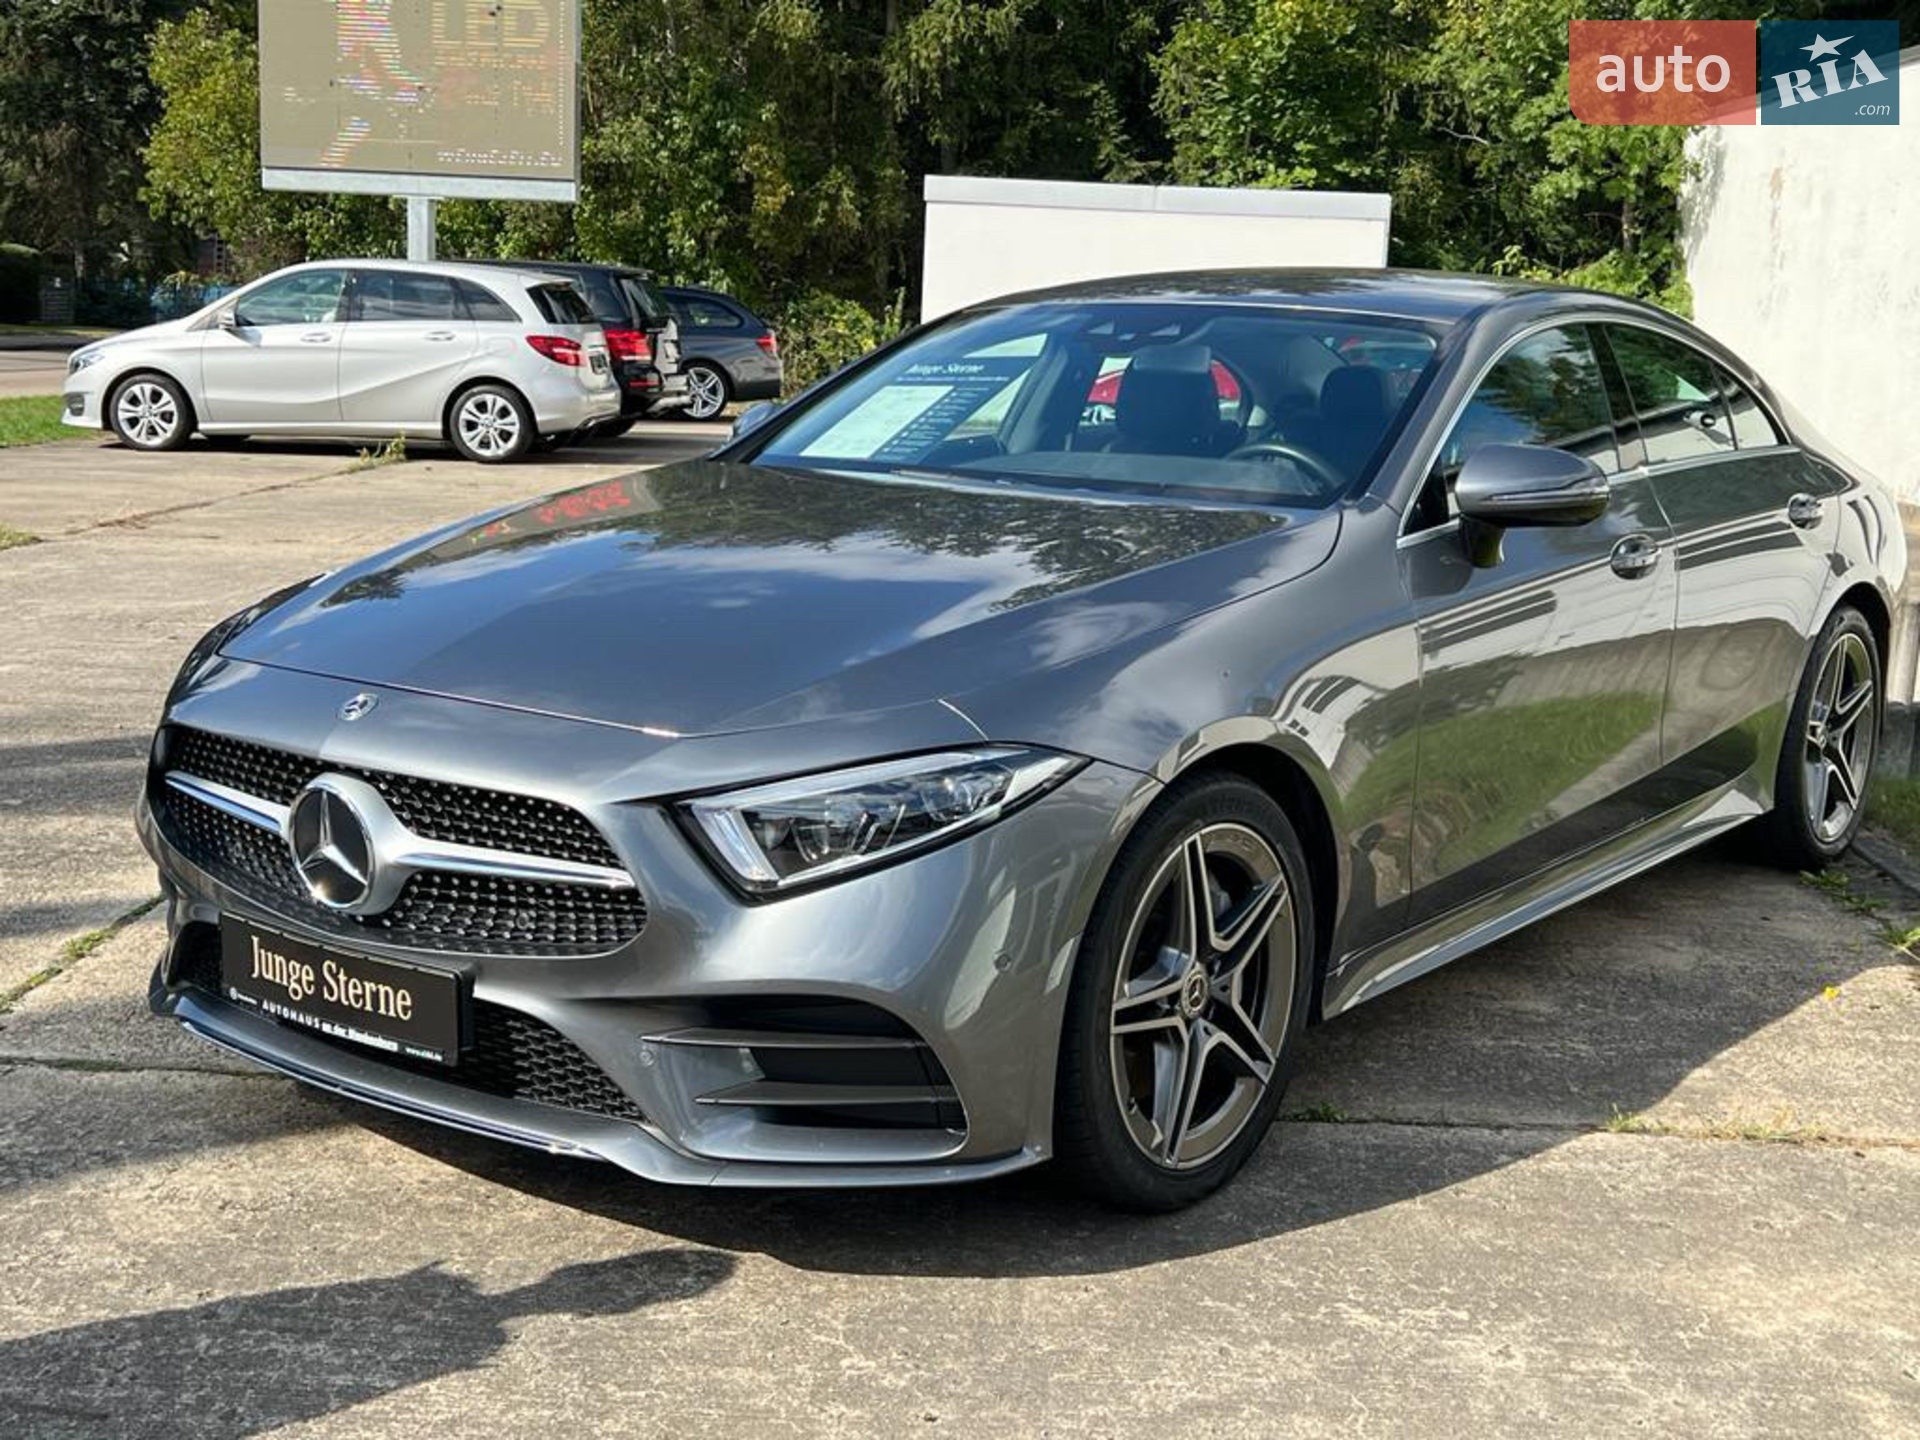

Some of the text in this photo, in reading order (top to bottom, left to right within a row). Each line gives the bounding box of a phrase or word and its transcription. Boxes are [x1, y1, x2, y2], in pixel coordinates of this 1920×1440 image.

[251, 935, 412, 1021] Junge Sterne
[262, 999, 320, 1029] AUTOHAUS
